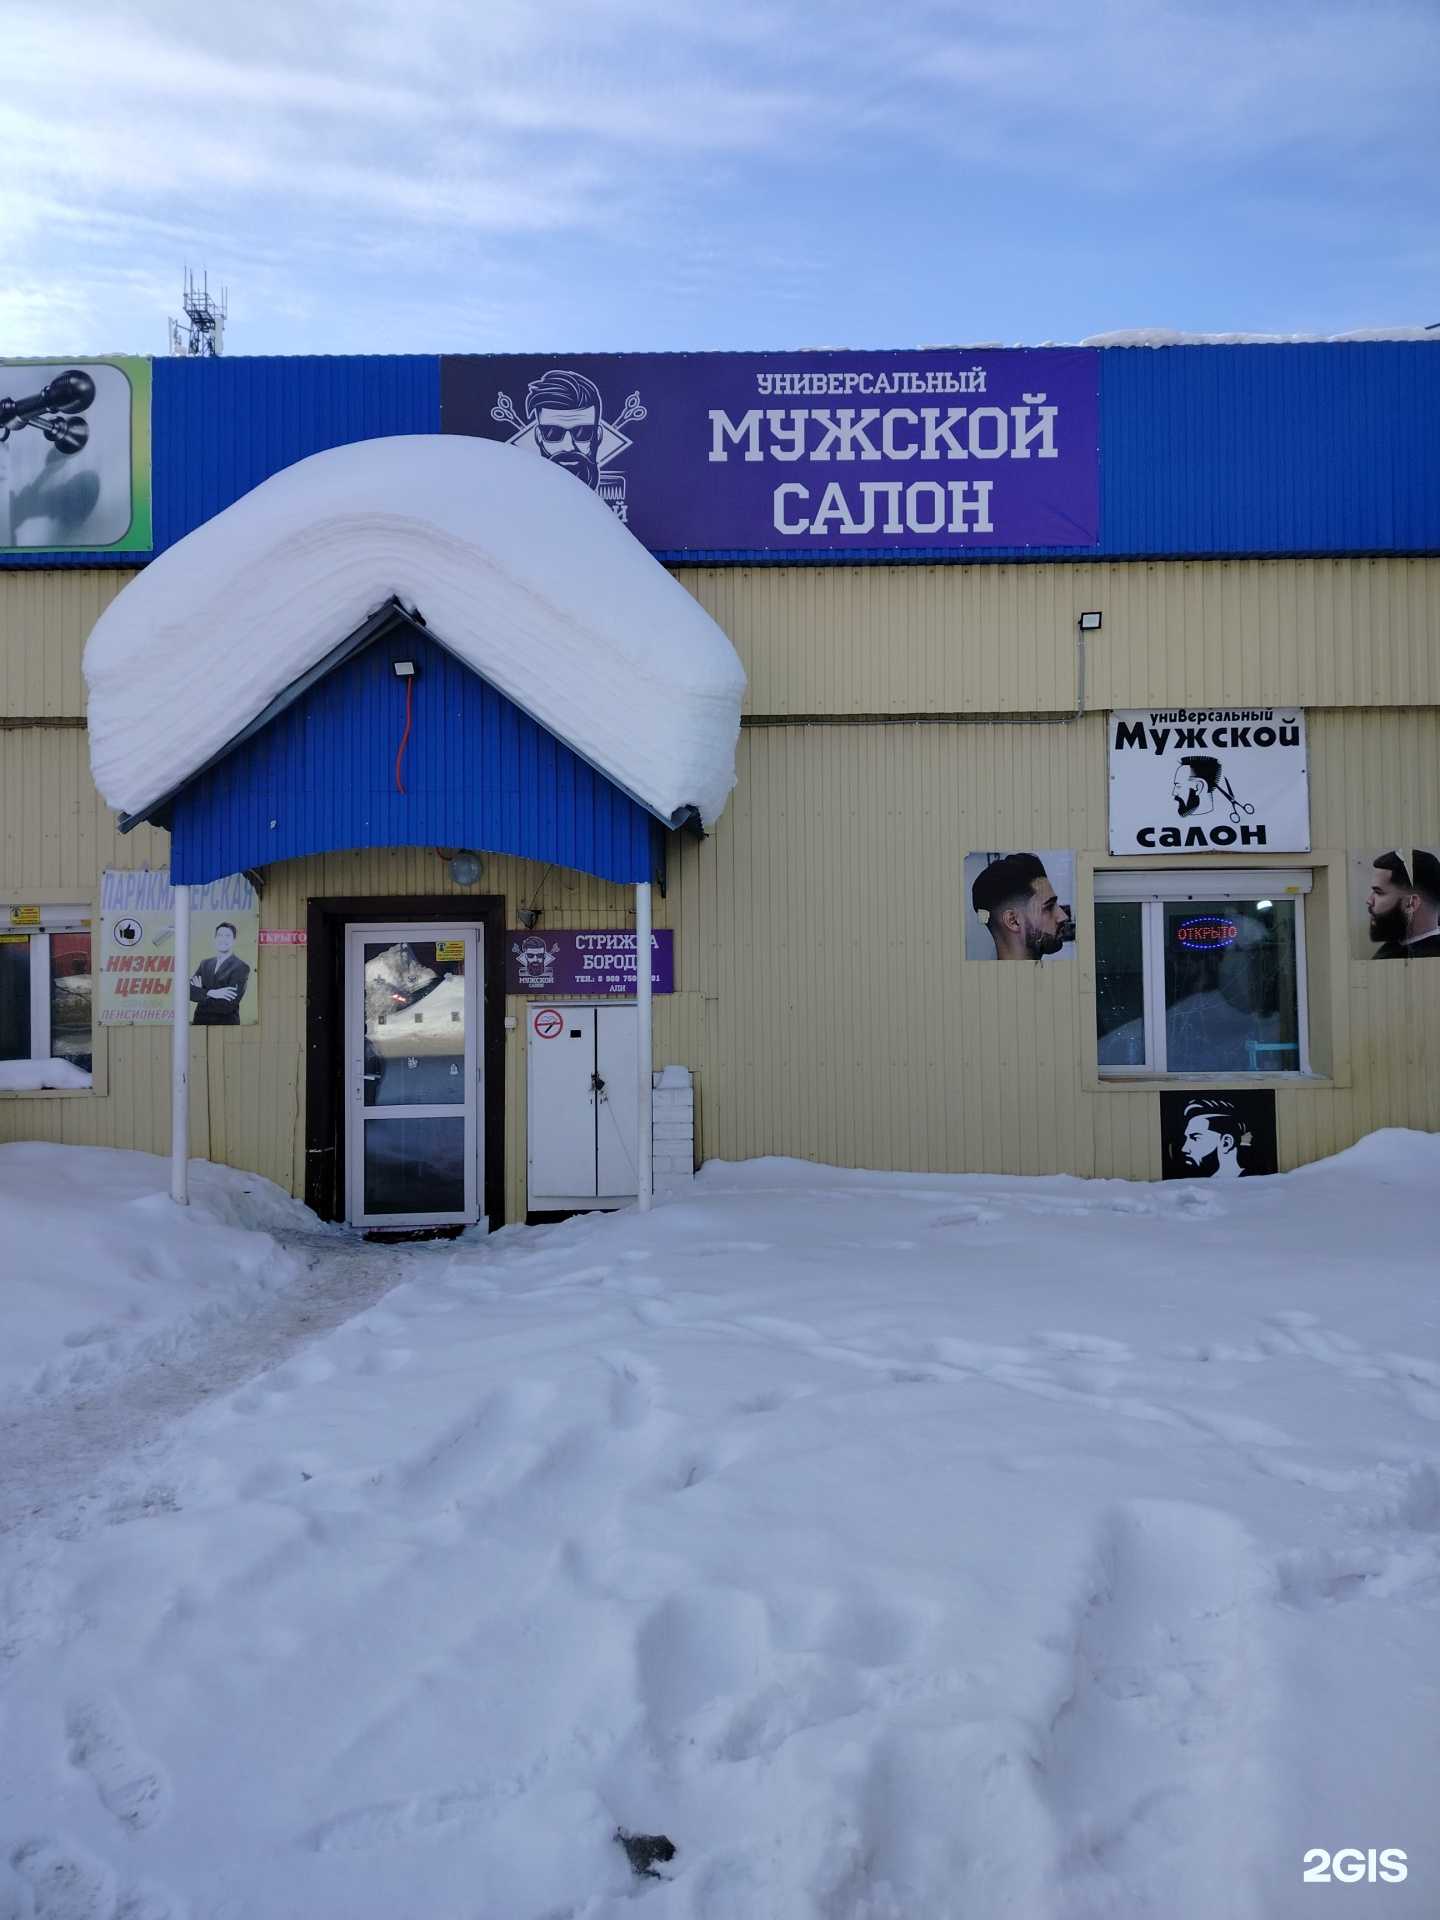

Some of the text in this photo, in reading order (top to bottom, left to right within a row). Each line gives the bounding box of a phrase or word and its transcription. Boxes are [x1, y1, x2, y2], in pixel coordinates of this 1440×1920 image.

[757, 366, 987, 395] УНИВЕРСАЛЬНЫЙ
[708, 393, 1058, 462] МУЖСКОЙ
[773, 480, 994, 535] САЛОН
[1150, 709, 1274, 726] универсальный
[1115, 717, 1300, 756] Мужской
[1136, 824, 1267, 848] салон
[575, 934, 660, 950] СТРИЖА
[1178, 926, 1238, 940] ОТКРЫТО
[583, 954, 638, 971] БОРОД
[114, 977, 172, 998] ЦЕНЫ
